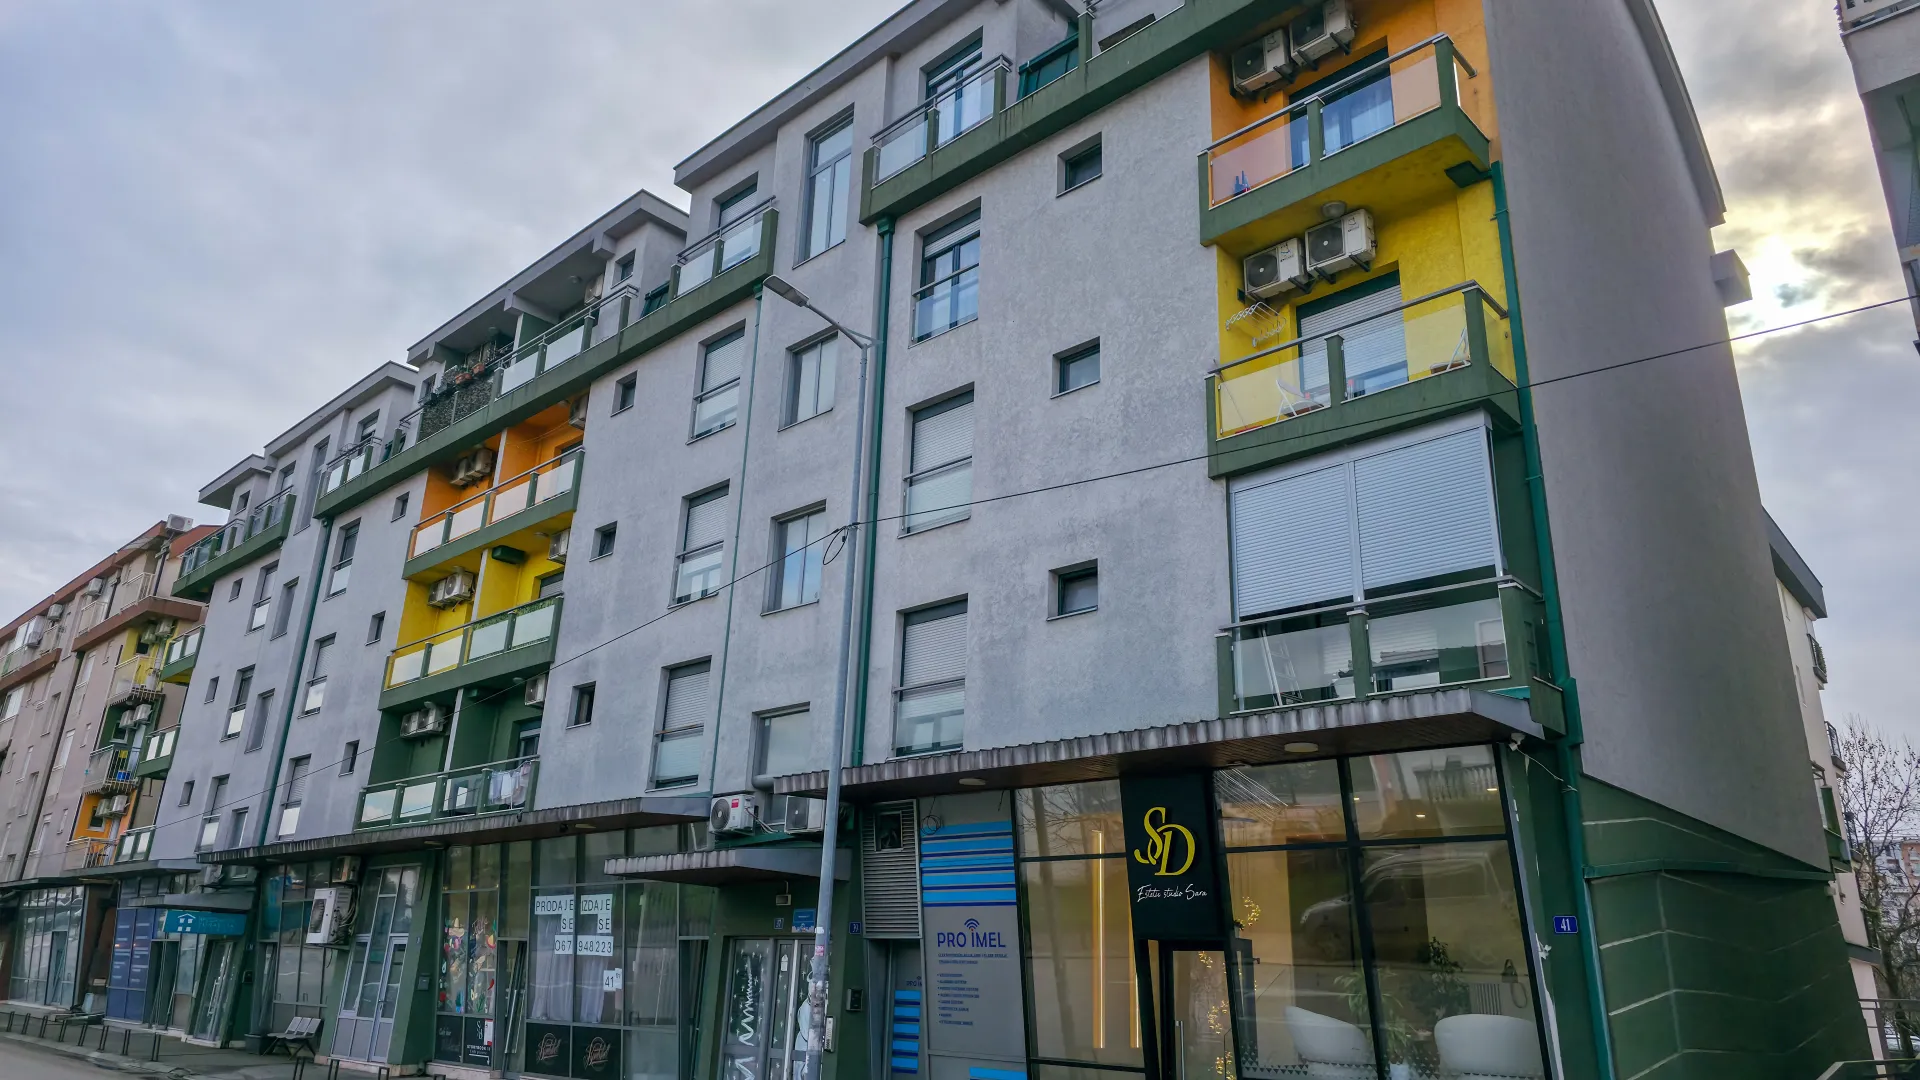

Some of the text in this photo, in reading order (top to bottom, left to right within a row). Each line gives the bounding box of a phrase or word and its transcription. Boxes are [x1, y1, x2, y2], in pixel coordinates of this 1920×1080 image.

[535, 899, 611, 912] PRODAJE IZDAJE
[561, 918, 610, 931] SE SE
[1560, 917, 1571, 931] 41
[937, 932, 1006, 948] PRO IMEL
[555, 940, 612, 954] 067 948223
[605, 976, 614, 988] 41
